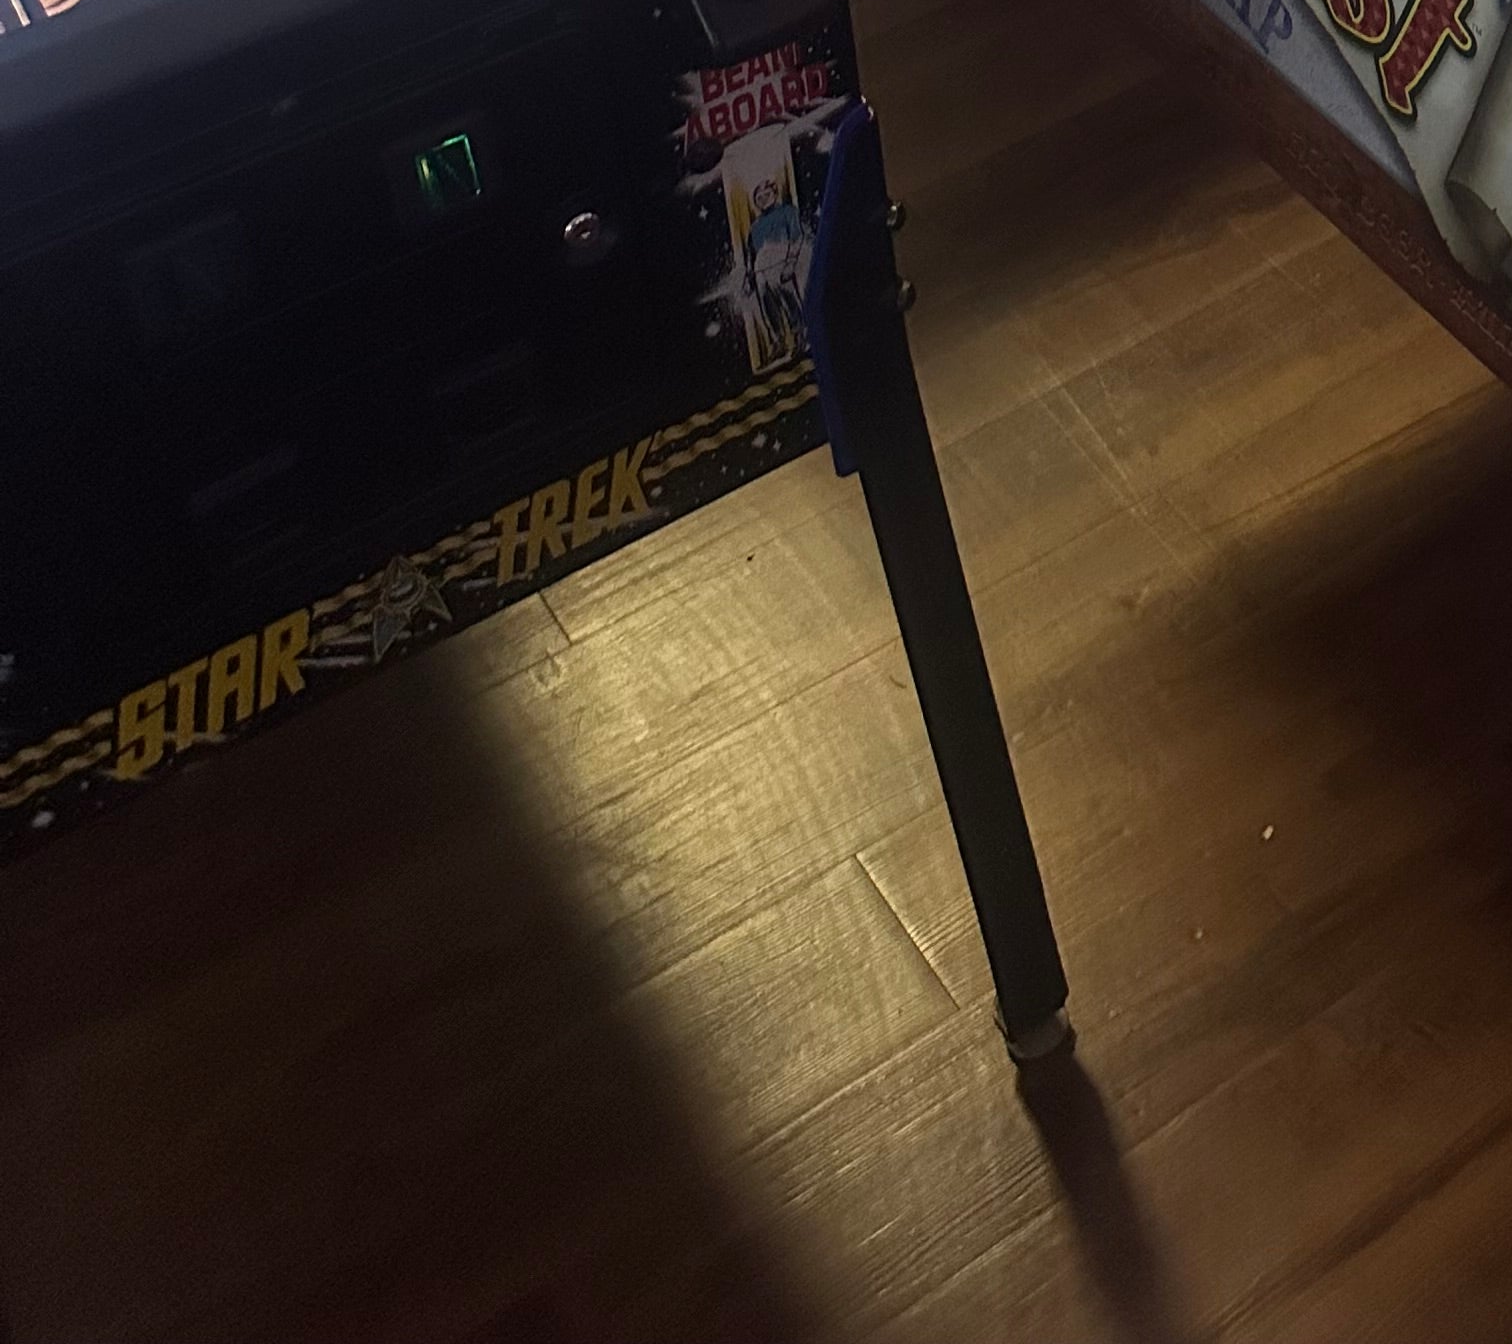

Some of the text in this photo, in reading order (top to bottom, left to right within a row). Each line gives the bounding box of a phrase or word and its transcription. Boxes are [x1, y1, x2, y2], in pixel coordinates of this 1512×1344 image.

[686, 62, 829, 145] ABOARD
[699, 41, 801, 105] BEAM
[491, 430, 660, 587] TREK
[110, 605, 315, 780] STAR
